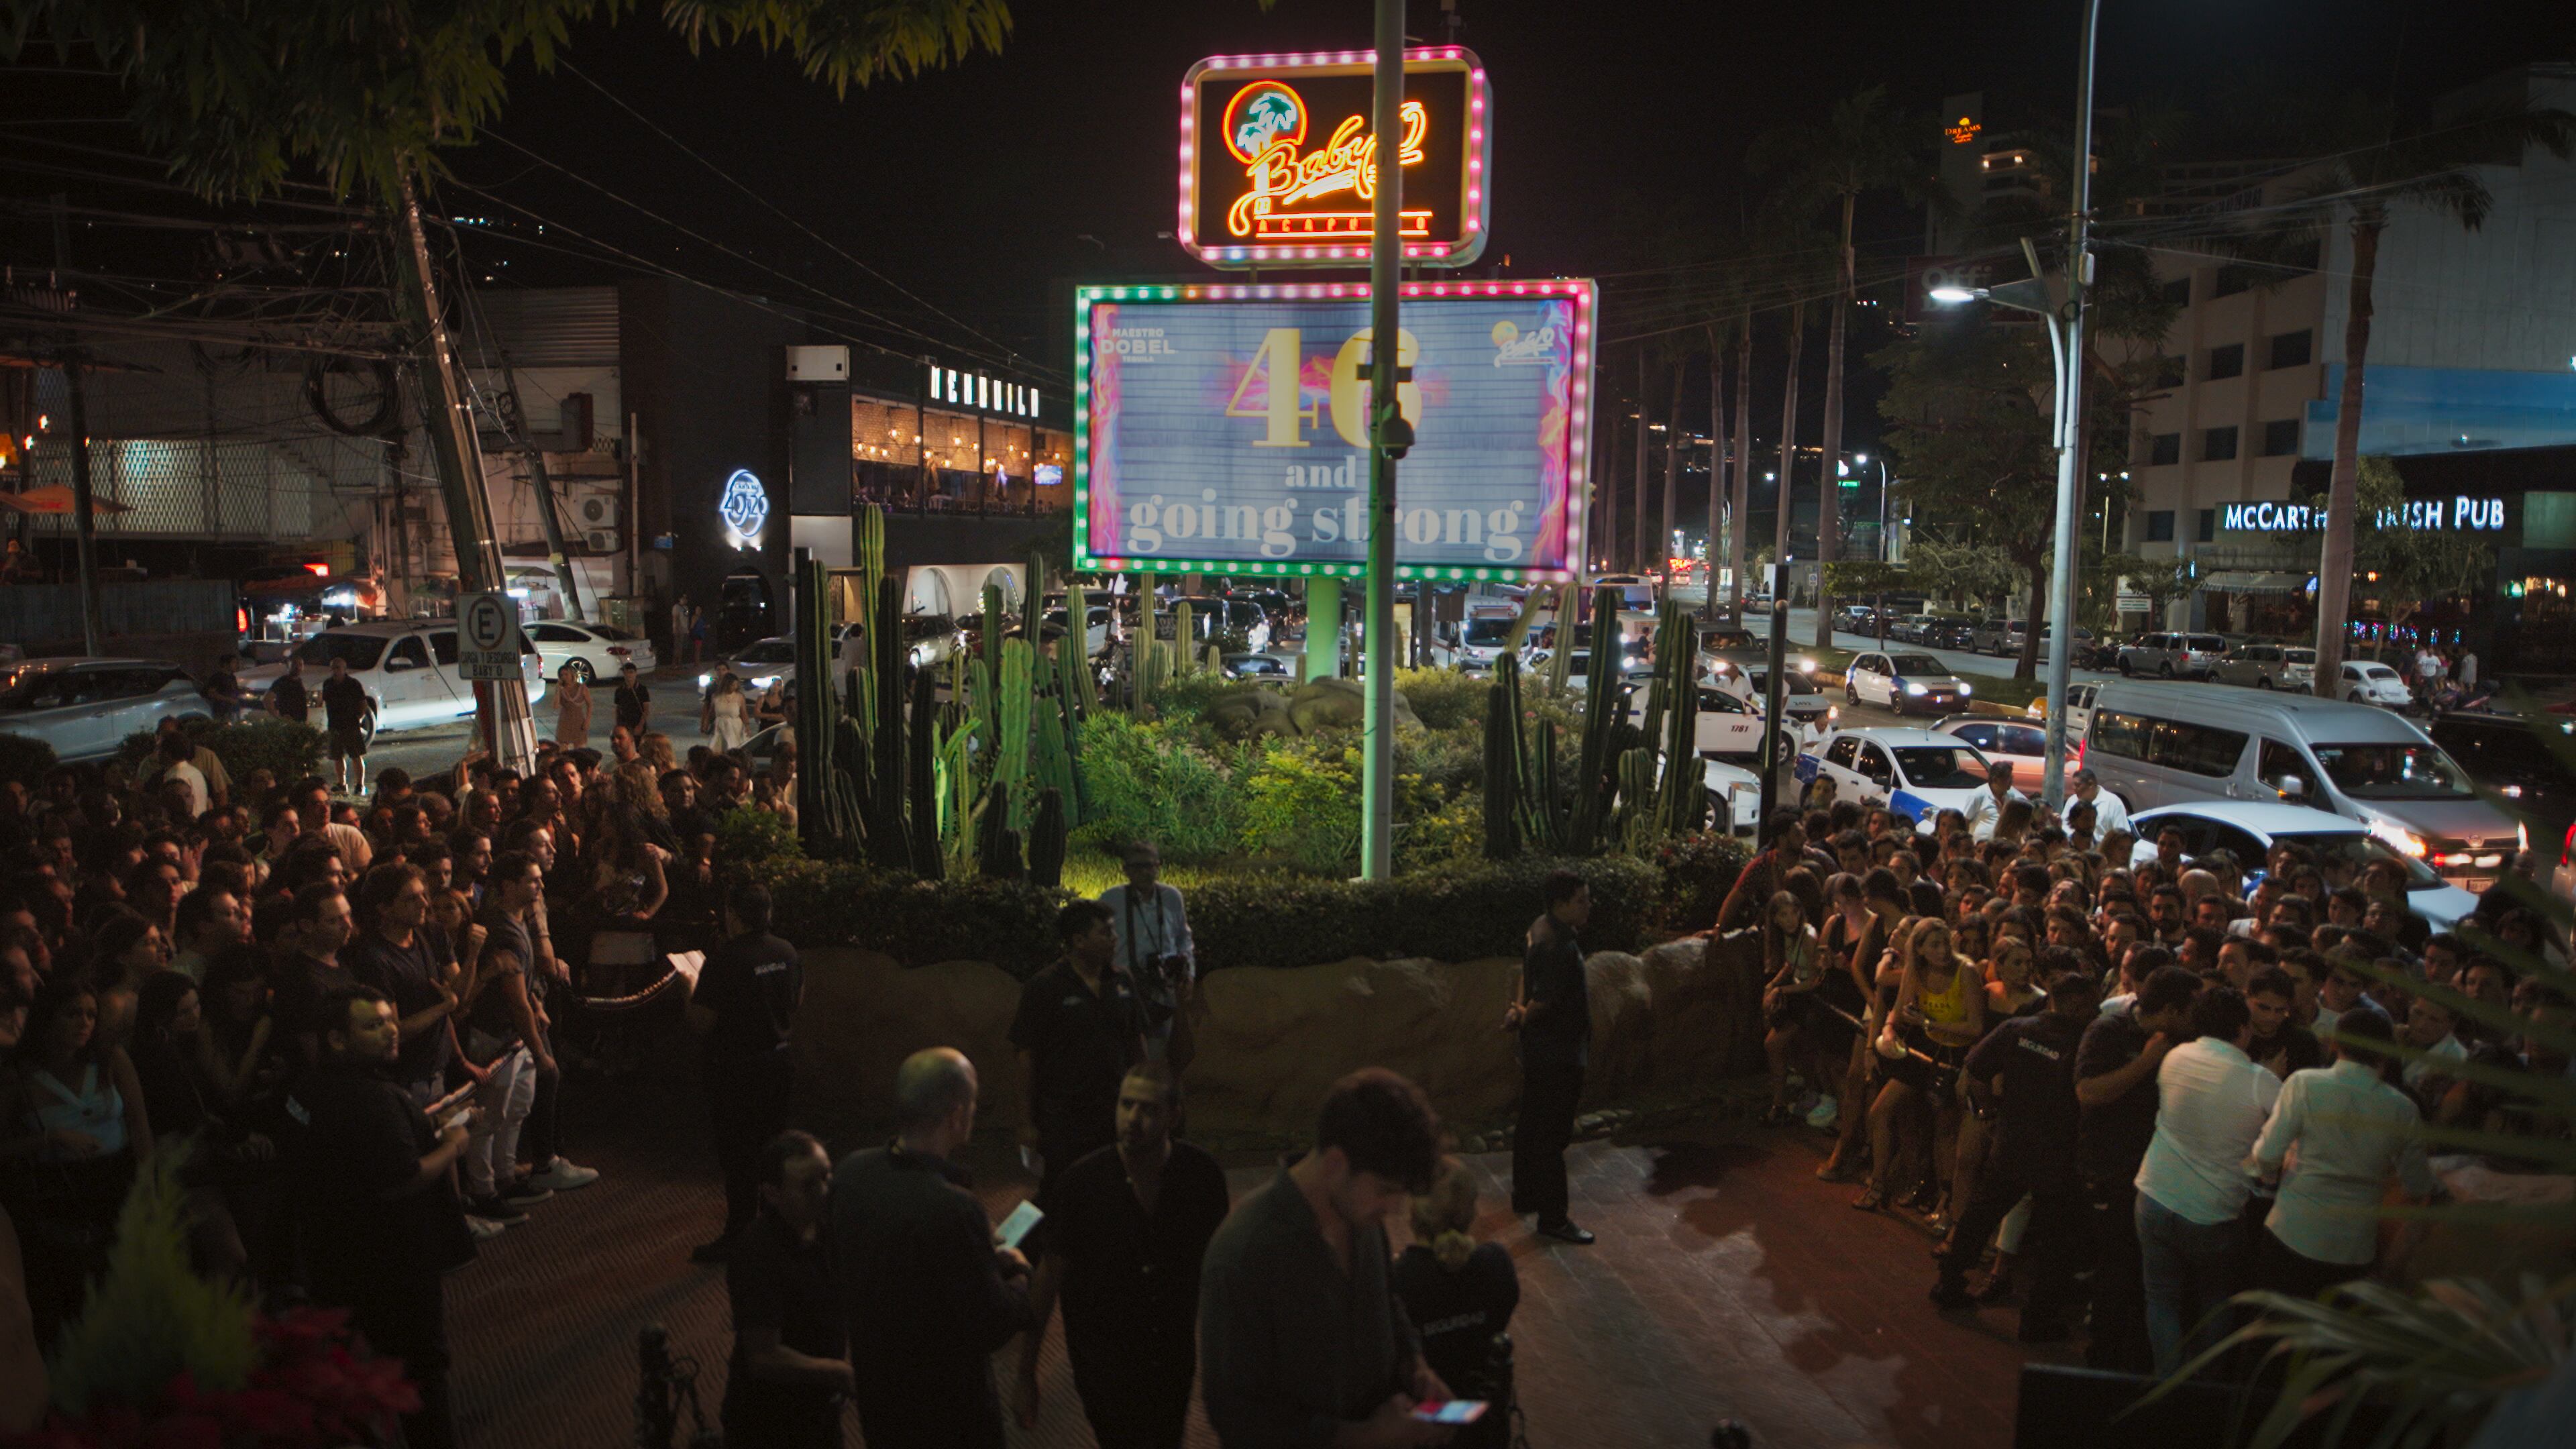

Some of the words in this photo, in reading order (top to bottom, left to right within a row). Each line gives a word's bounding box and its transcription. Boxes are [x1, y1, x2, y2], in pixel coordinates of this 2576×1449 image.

[1944, 123, 1982, 135] DREAMS
[1258, 216, 1428, 233] ACAPUO
[1100, 339, 1176, 354] DOBEL
[1112, 328, 1164, 337] MAESTRO
[1226, 327, 1423, 449] 46
[1285, 455, 1356, 488] and
[1127, 488, 1298, 557] going
[1311, 496, 1524, 561] stong
[2454, 495, 2505, 530] PUB
[478, 608, 494, 639] E
